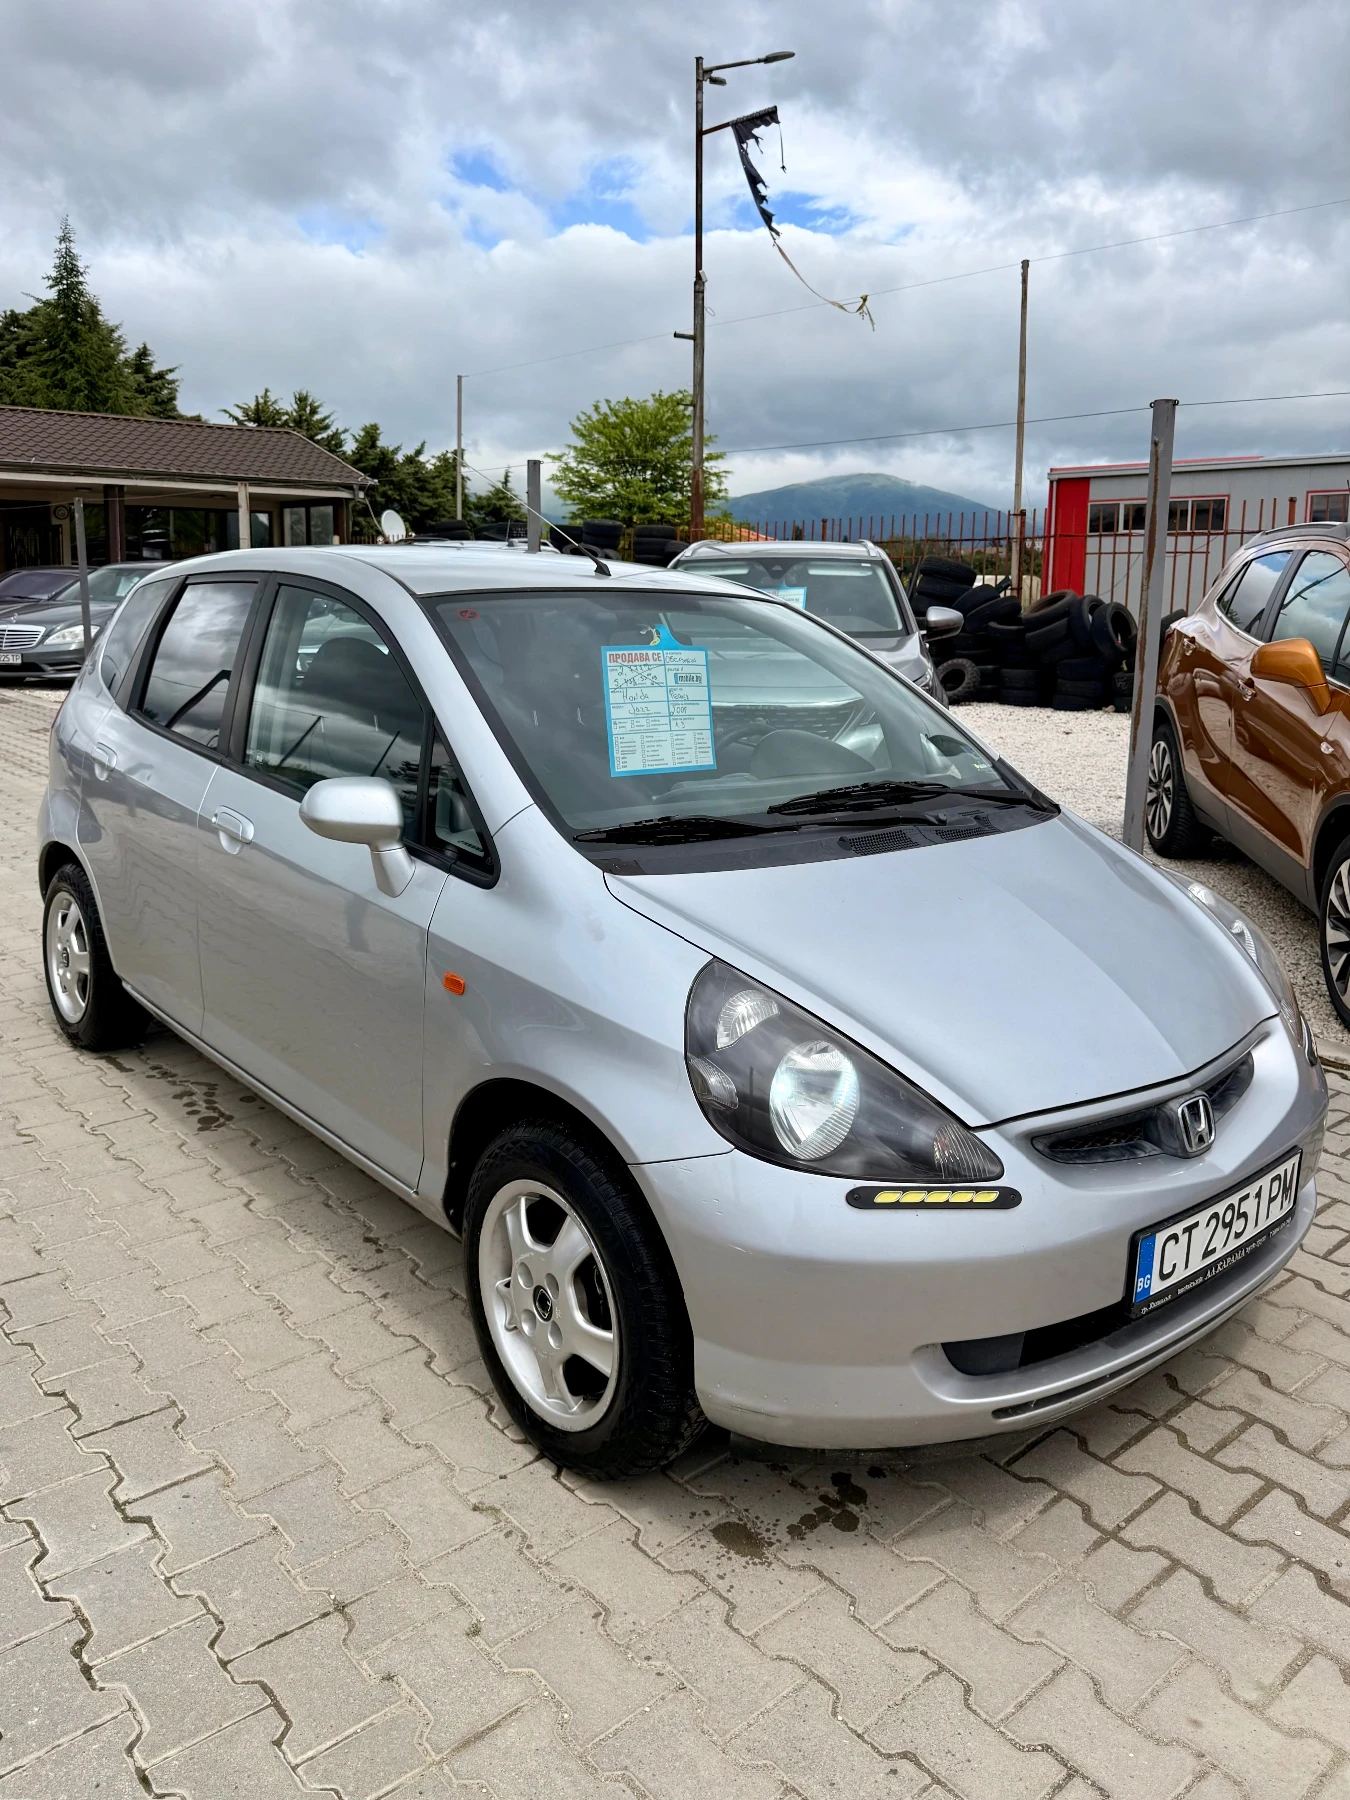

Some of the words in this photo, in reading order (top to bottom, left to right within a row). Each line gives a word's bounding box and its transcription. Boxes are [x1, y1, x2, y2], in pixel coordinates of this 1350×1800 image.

[608, 652, 651, 664] ПРОДАВА
[652, 652, 662, 662] СЕ
[678, 674, 702, 684] mobile.bg
[1159, 1220, 1200, 1281] CT
[1201, 1185, 1263, 1261] 2951
[1265, 1162, 1296, 1220] PM
[1137, 1274, 1151, 1293] BG
